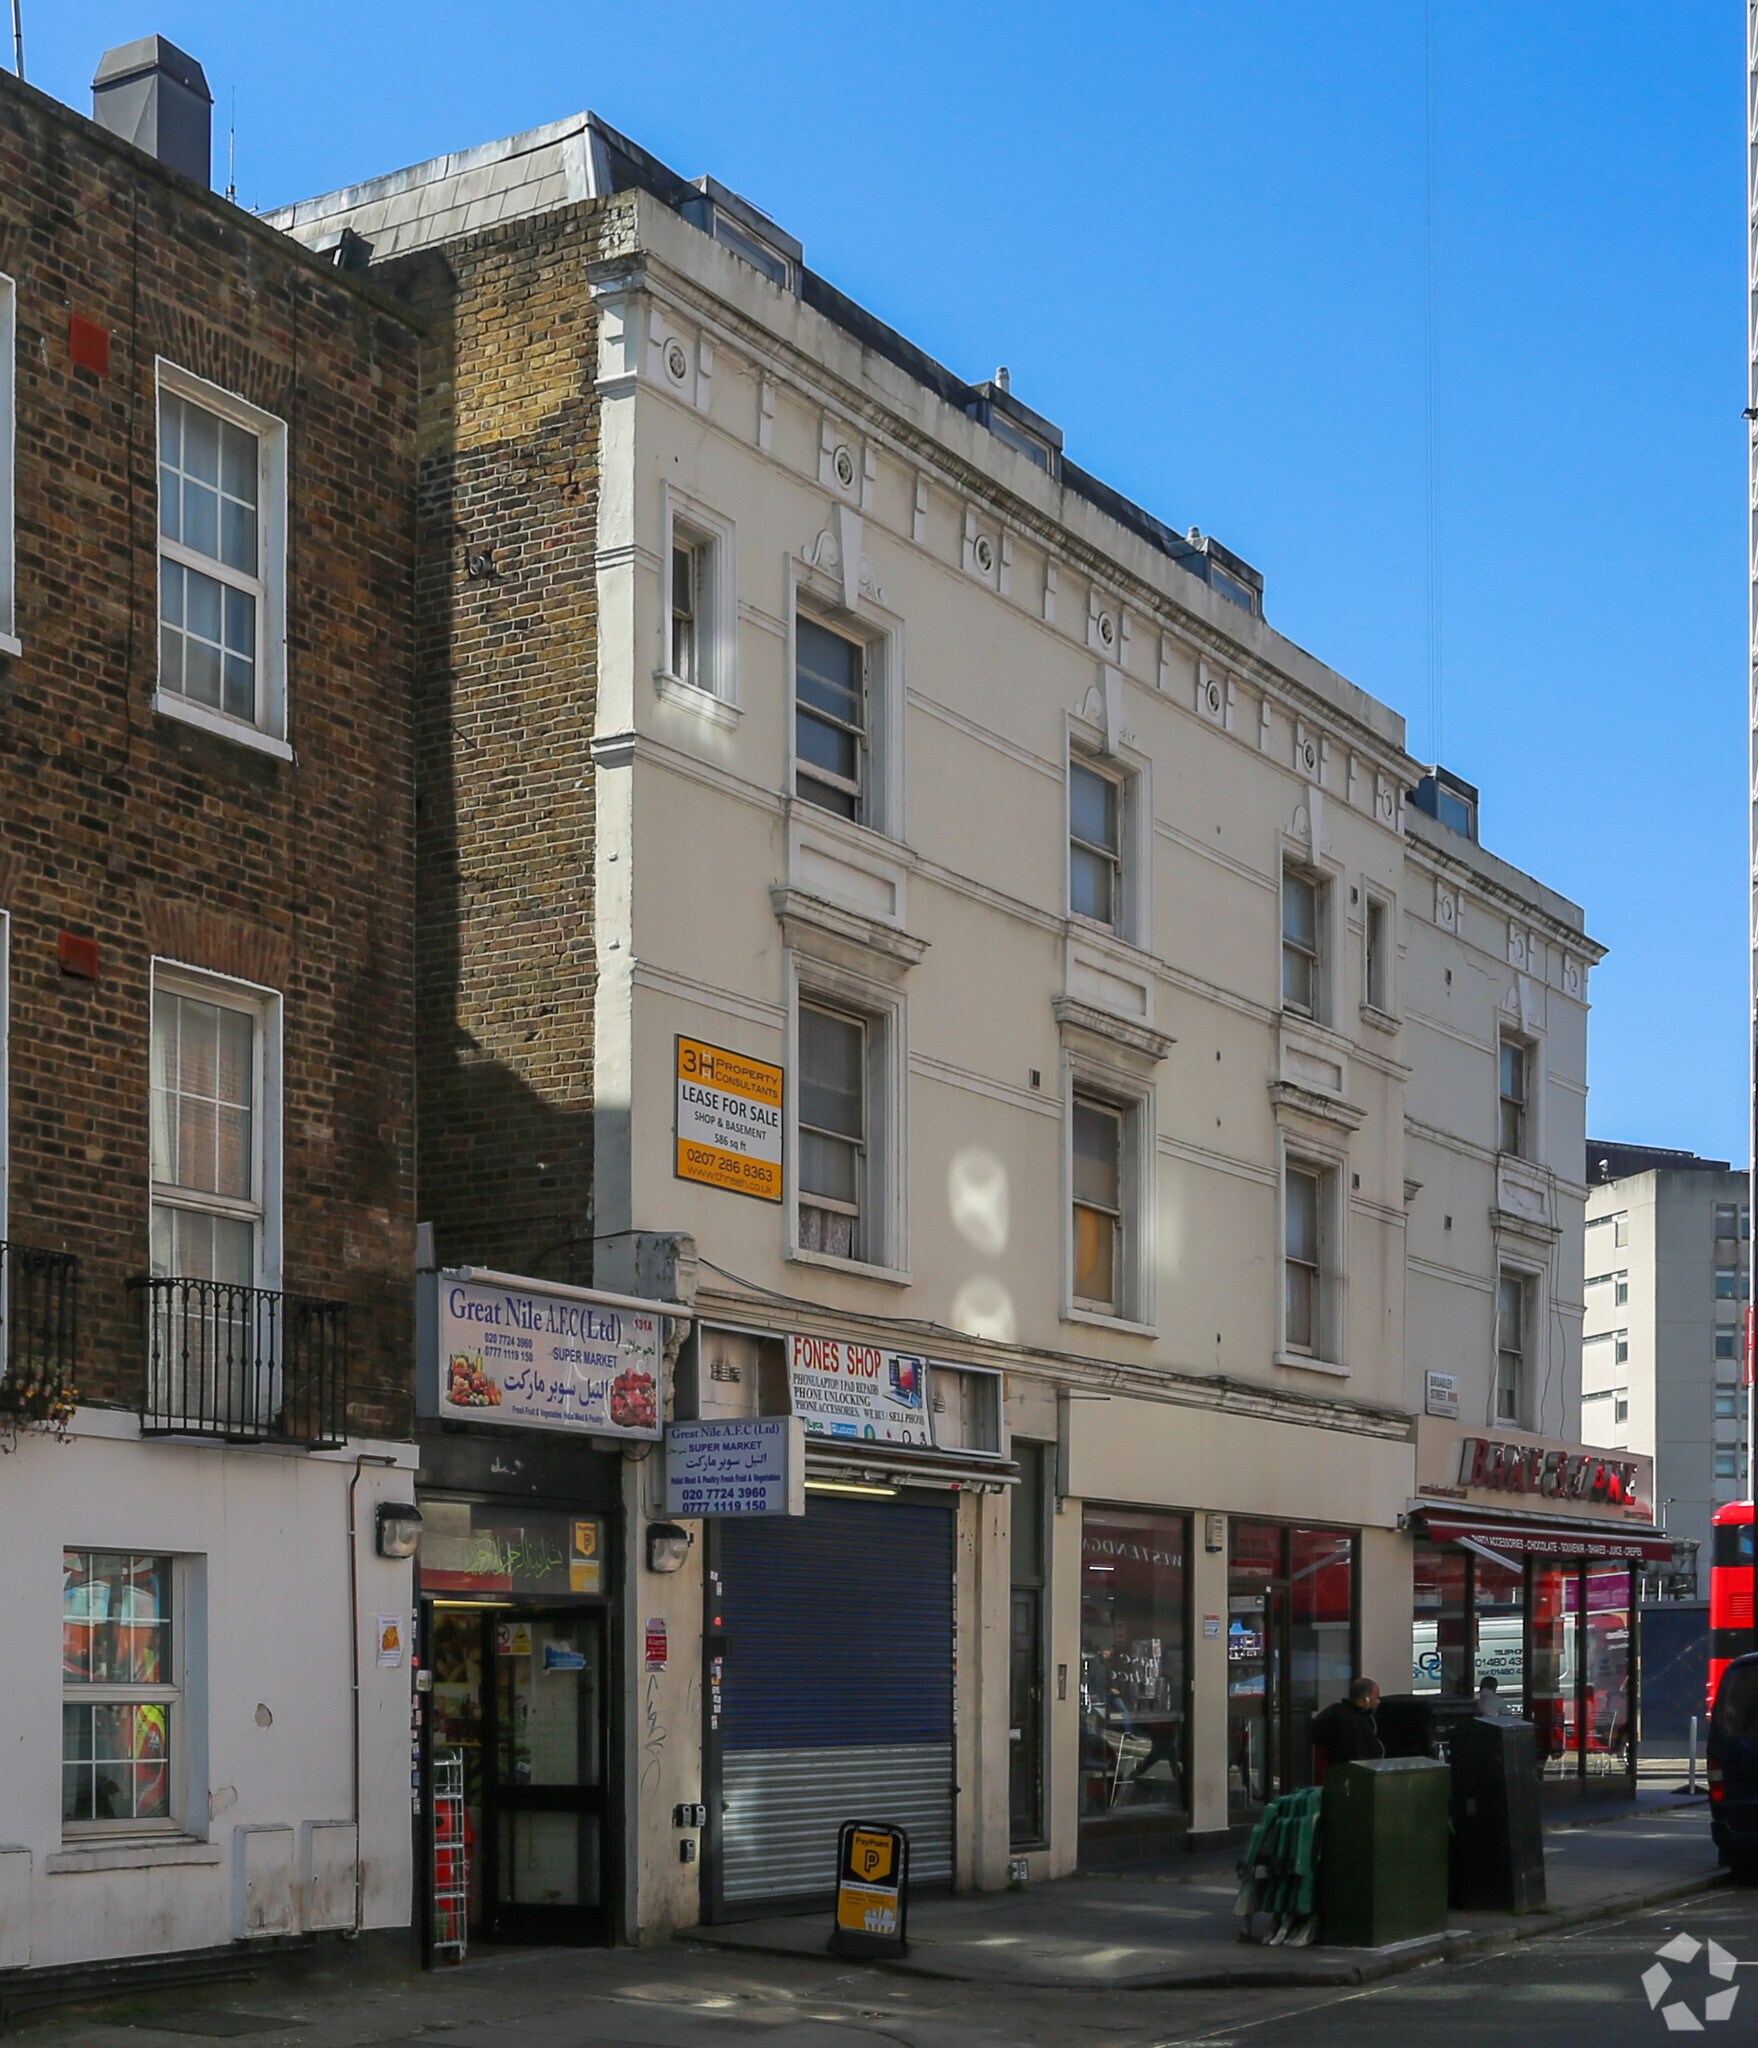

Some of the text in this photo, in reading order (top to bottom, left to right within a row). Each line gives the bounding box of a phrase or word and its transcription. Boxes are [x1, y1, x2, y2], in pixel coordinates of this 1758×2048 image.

[715, 1058, 778, 1085] PROPERTY
[715, 1071, 778, 1099] CONSULTANTS
[682, 1085, 778, 1127] LEASE FOR SALE
[694, 1110, 767, 1140] SHOP & BASEMENT
[714, 1133, 747, 1151] 586 sq ft
[687, 1148, 773, 1182] 0207 286 8363
[449, 1288, 502, 1325] Great
[505, 1297, 543, 1331] Nile
[484, 1332, 533, 1350] 020 7724 3960
[484, 1346, 534, 1362] 0777 1119 150
[552, 1347, 618, 1369] SUPER MARKET
[793, 1337, 881, 1379] FONES SHOP
[503, 1367, 609, 1406] النيل سوبر ماركت
[794, 1386, 871, 1407] PHONE UNLOCKING
[795, 1400, 817, 1412] PHONE
[889, 1411, 904, 1423] SELL
[672, 1424, 780, 1439] Great Nile A.F.C (Ltd)
[688, 1441, 762, 1453] SUPER MARKET
[686, 1453, 767, 1471] النيل سوبر ماركت
[1458, 1437, 1545, 1493] BAKE
[682, 1487, 766, 1500] 020 7724 3960
[682, 1500, 766, 1513] 0777 1119 150
[1489, 1536, 1524, 1550] ACCESSORIES
[1527, 1540, 1558, 1552] CHOCOLATE
[1475, 1658, 1506, 1667] 01480
[855, 1836, 890, 1849] PayPoint
